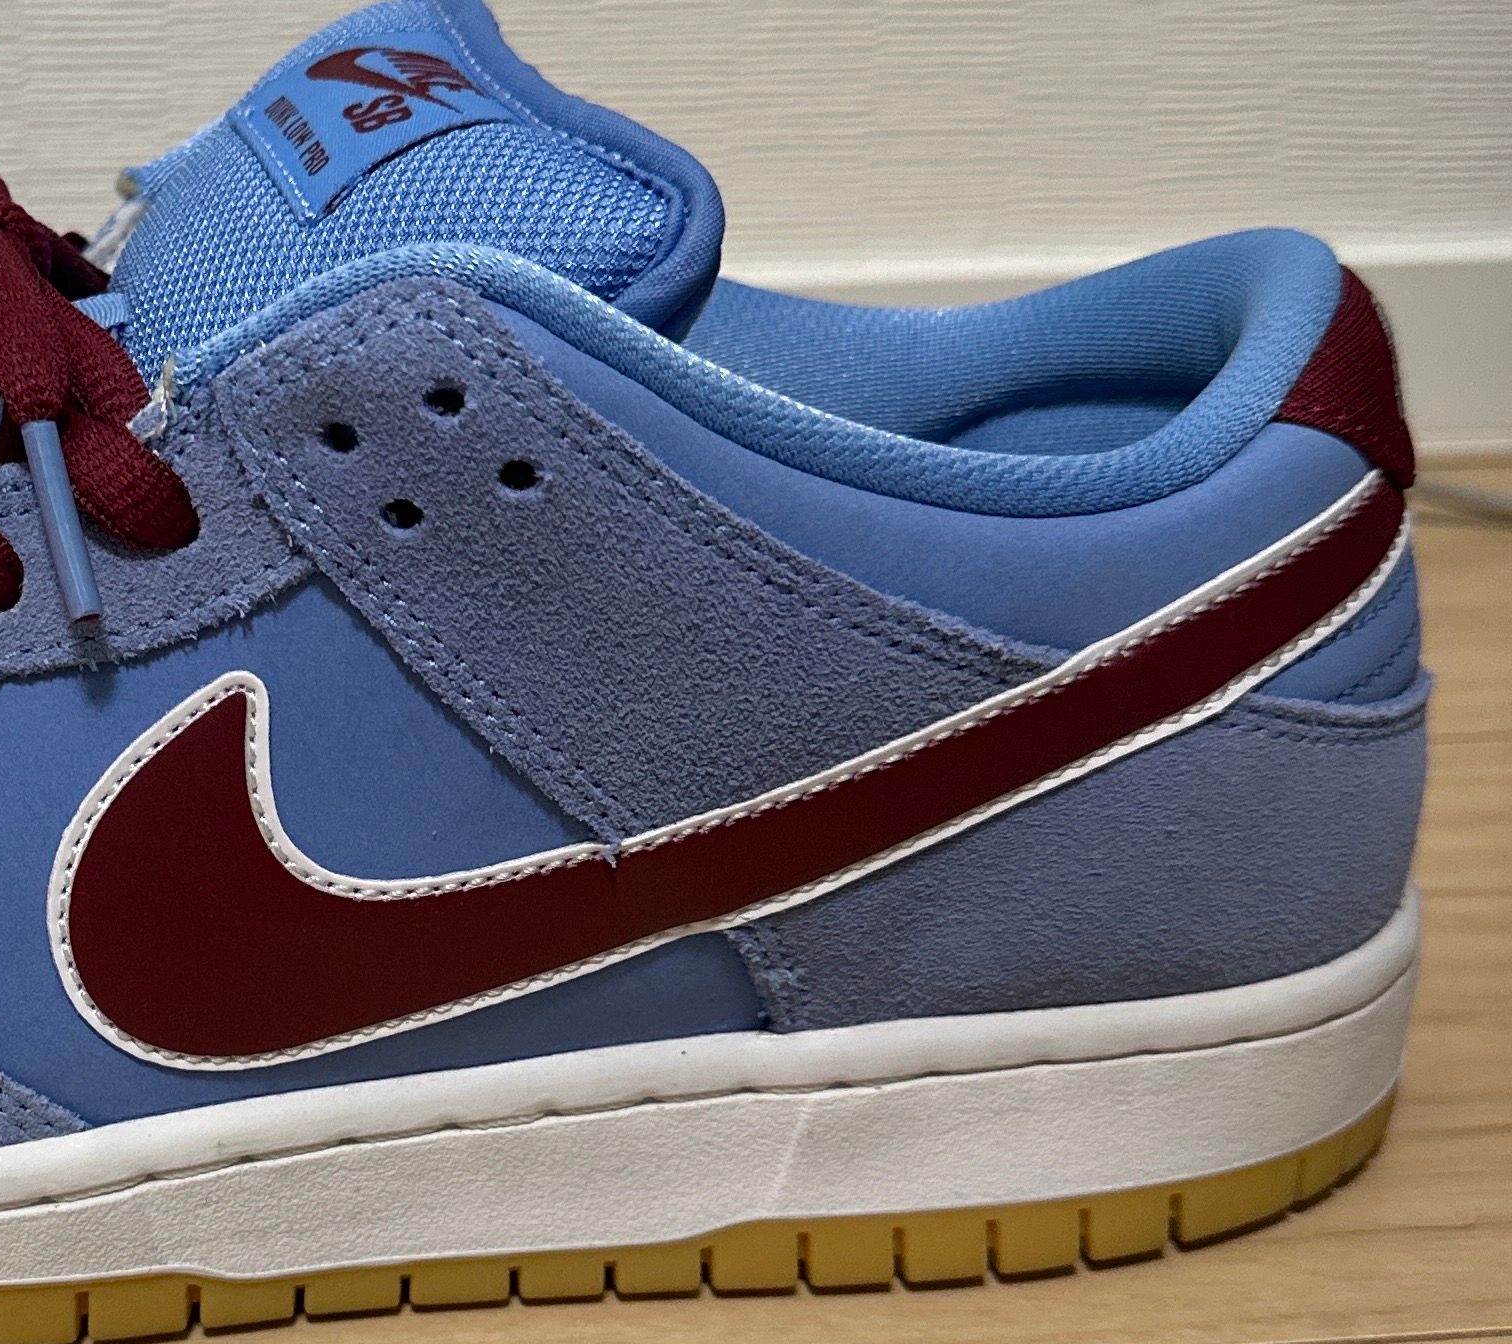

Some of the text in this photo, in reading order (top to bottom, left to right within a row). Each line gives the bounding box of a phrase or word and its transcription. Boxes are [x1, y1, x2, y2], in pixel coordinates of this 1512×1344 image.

[342, 94, 413, 134] SB
[282, 116, 314, 150] LOW
[298, 140, 330, 176] PRO
